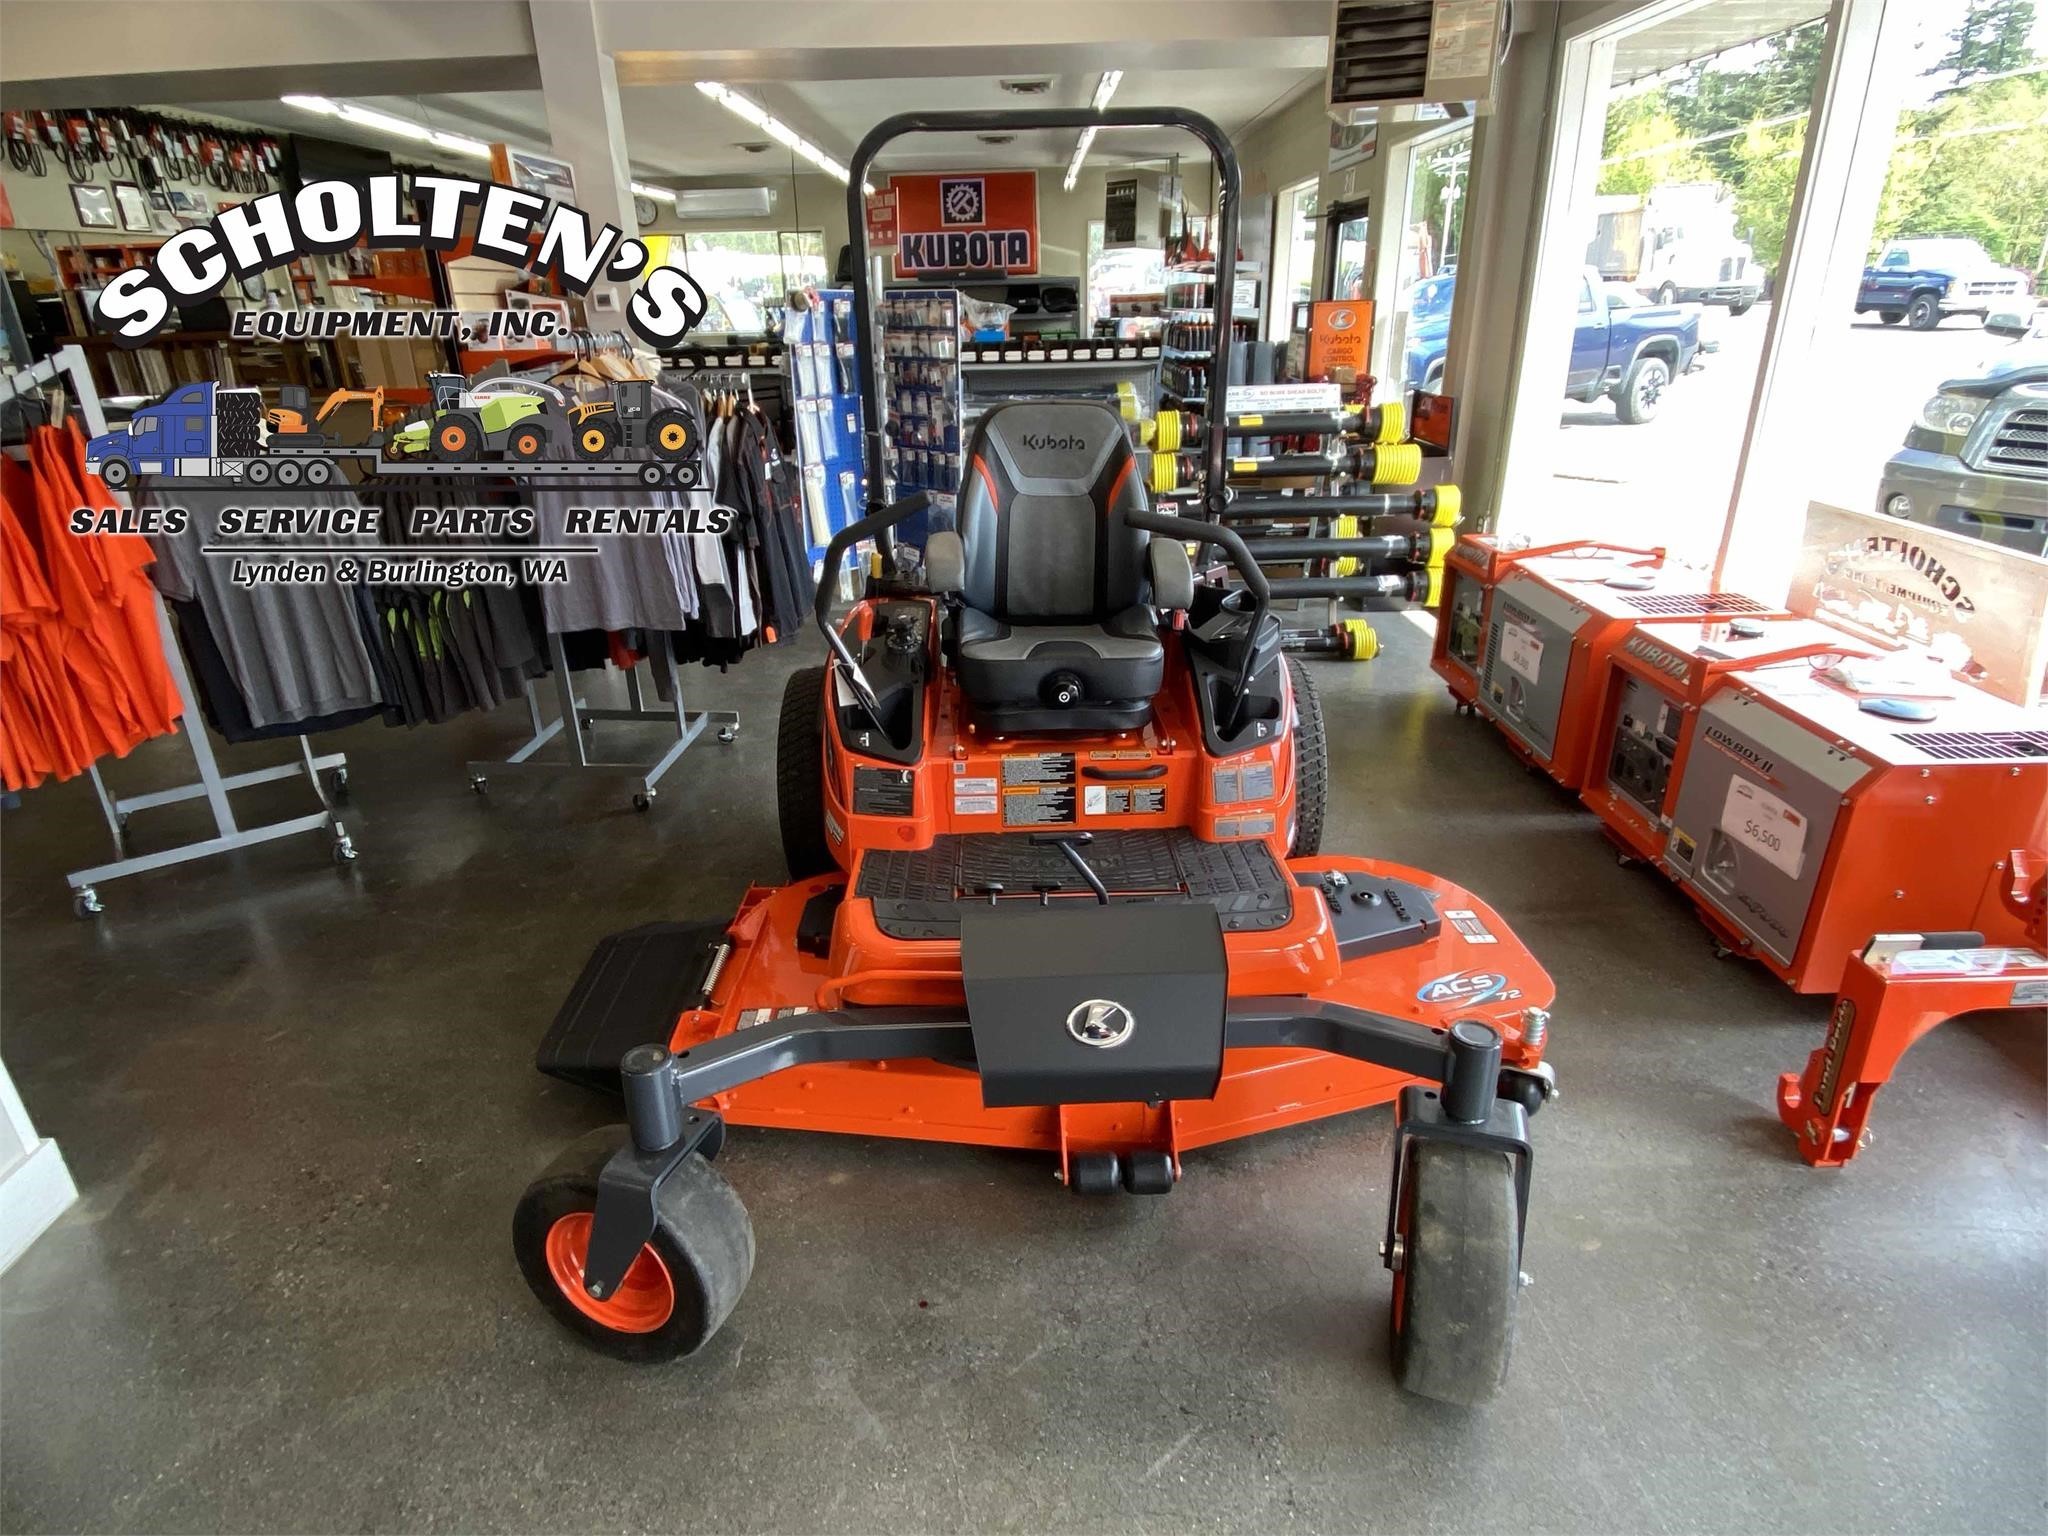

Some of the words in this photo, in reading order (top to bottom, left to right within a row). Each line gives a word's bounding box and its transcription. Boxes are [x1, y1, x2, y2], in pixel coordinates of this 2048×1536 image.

[901, 230, 1030, 270] KUBOTA
[1320, 335, 1361, 345] Kubota
[1023, 434, 1085, 450] Kubota
[1625, 636, 1688, 678] KUBOTA
[1704, 726, 1762, 762] LOWBOY
[1744, 819, 1781, 852] $6,500
[1432, 974, 1493, 999] ACS
[1496, 989, 1522, 1001] 72
